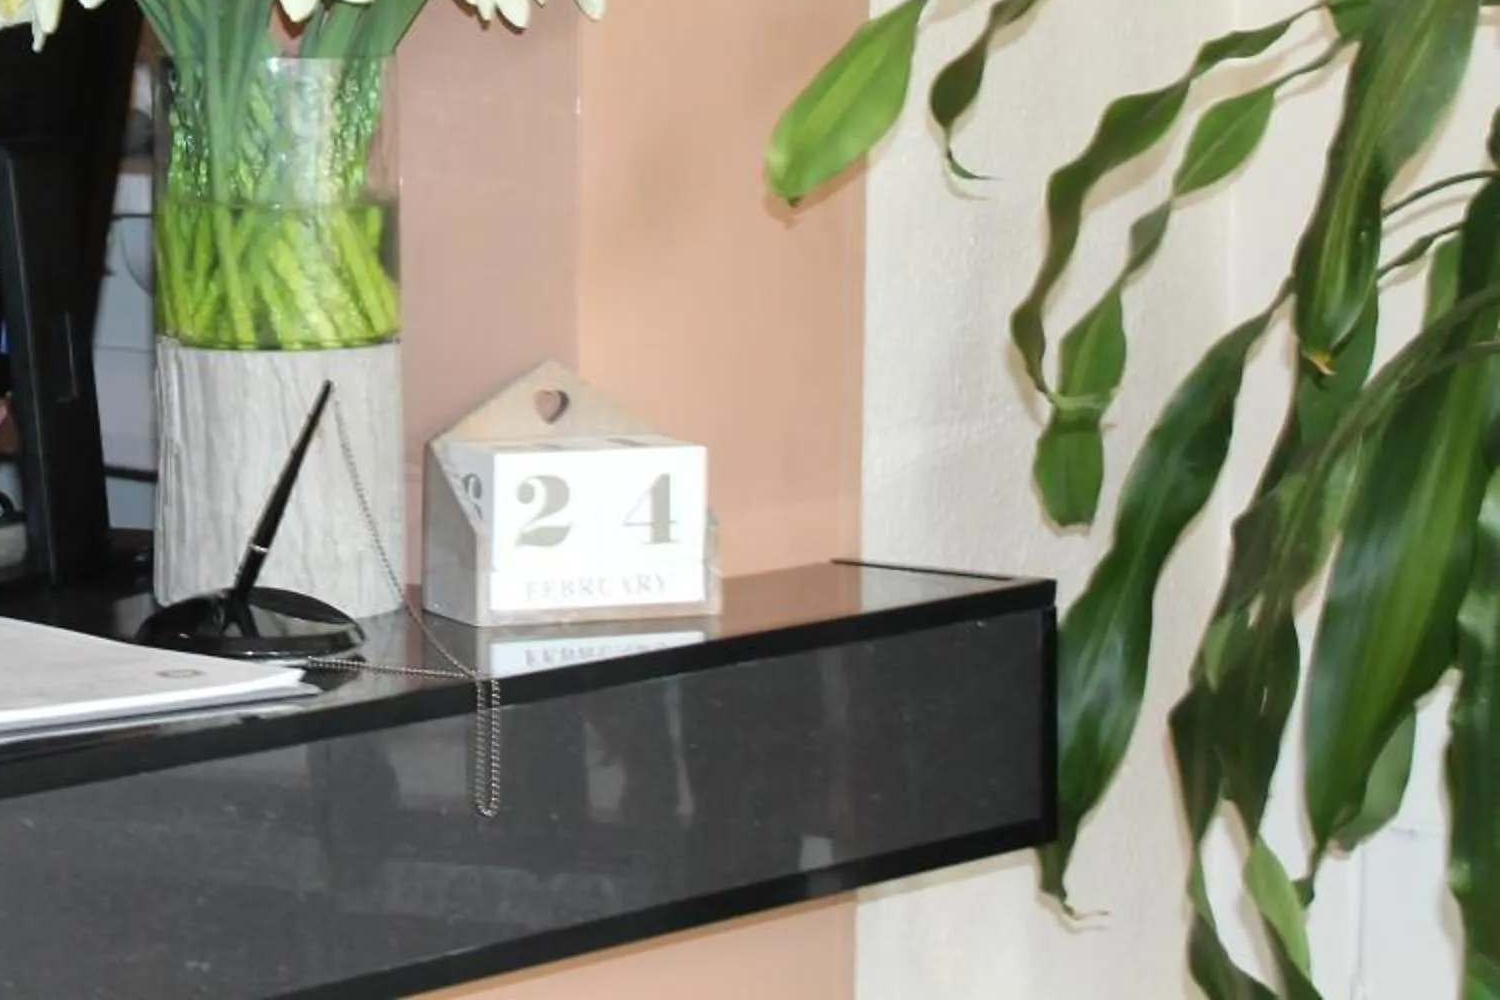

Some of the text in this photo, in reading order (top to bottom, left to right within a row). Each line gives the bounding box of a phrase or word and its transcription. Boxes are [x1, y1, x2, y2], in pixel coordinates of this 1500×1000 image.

[515, 474, 573, 548] 2
[622, 473, 679, 545] 4
[524, 573, 667, 601] FEBRUARY
